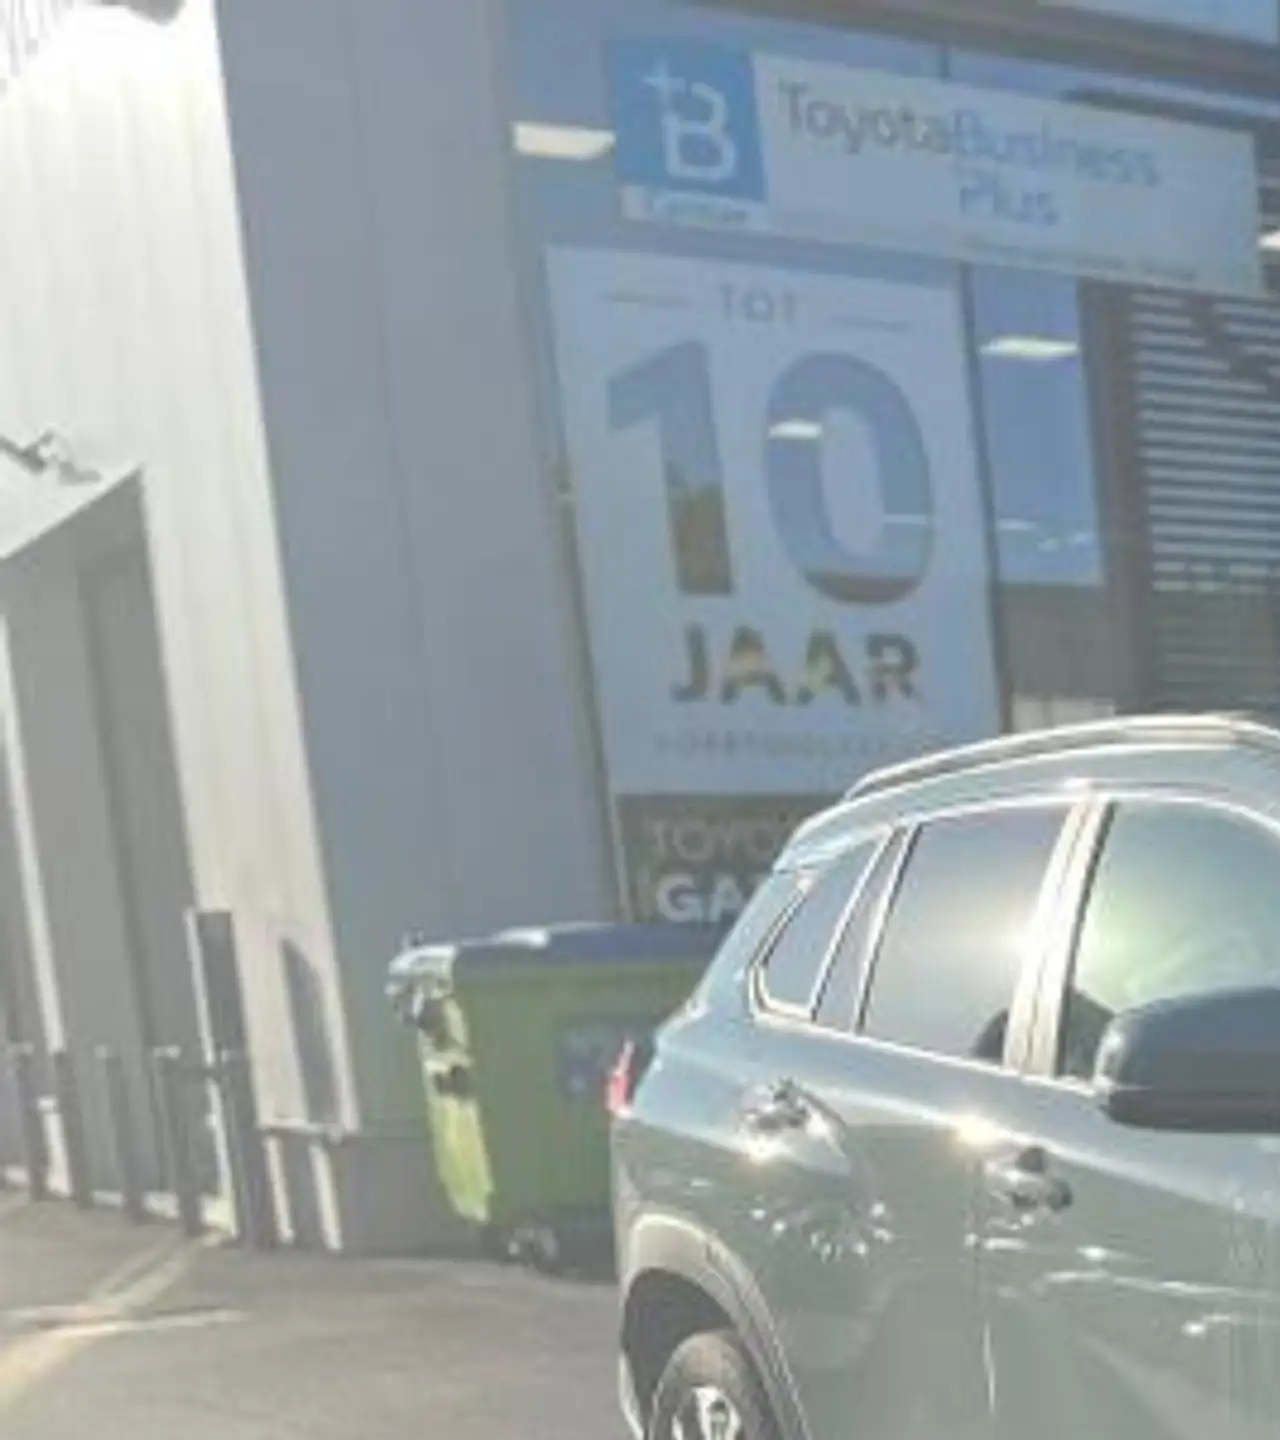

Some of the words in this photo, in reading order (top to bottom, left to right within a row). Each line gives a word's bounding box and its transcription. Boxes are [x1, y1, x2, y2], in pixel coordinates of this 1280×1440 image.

[958, 184, 1058, 228] Plus
[720, 282, 798, 323] TOT
[606, 338, 936, 608] 10
[669, 621, 924, 706] JAAR
[649, 814, 783, 864] TOYO
[655, 869, 766, 923] GA
